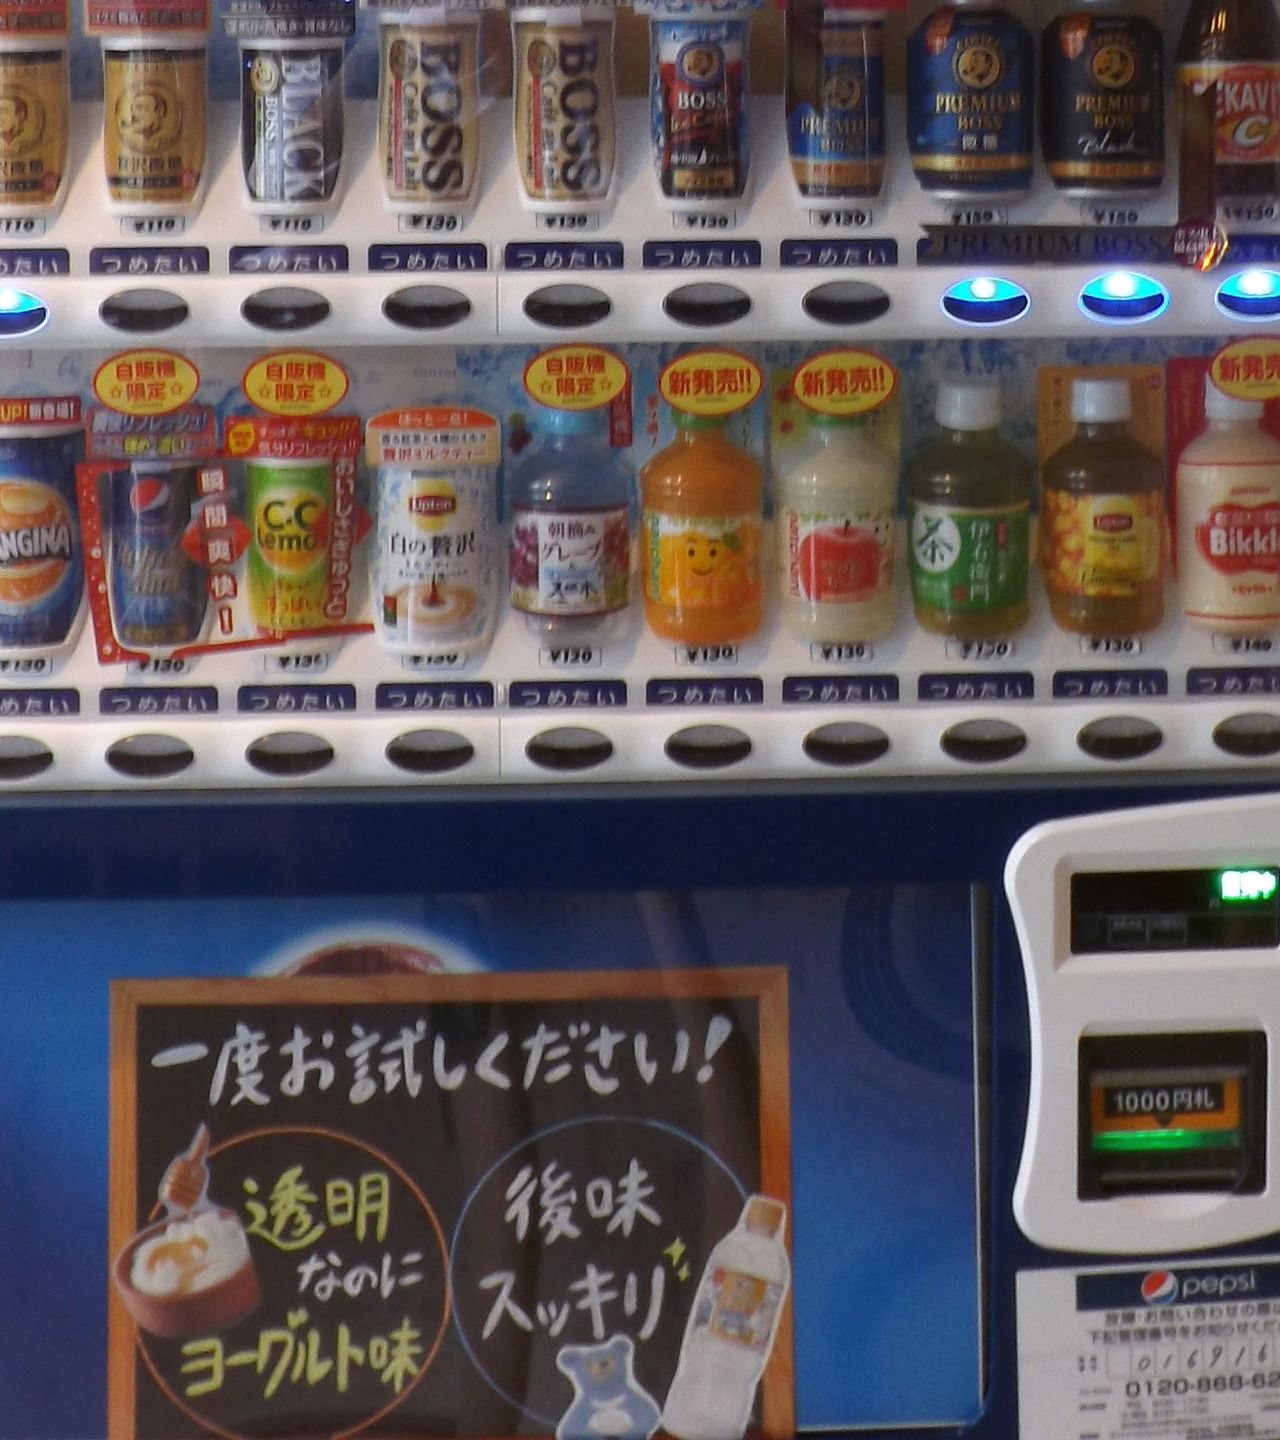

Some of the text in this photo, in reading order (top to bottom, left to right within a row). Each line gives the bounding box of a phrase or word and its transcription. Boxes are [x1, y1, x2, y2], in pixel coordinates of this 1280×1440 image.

[677, 91, 728, 111] BOSS
[935, 92, 1022, 113] PREMIUM
[1075, 94, 1150, 113] PREMIUM
[264, 96, 279, 142] BOSS
[421, 43, 464, 192] BOSS
[559, 39, 601, 192] BOSS
[958, 114, 1003, 130] BOSS
[1094, 113, 1135, 130] BOSS
[280, 55, 325, 200] BLACK
[100, 255, 198, 274] つめたい
[240, 253, 338, 273] つめたい
[378, 251, 477, 271] つめたい
[516, 250, 614, 269] つめたい
[654, 249, 751, 268] つめたい
[790, 247, 888, 266] つめたい
[115, 359, 176, 381] 自販機
[264, 361, 326, 382] 自販機
[545, 357, 606, 376] 自販機
[126, 382, 166, 401] 限定
[275, 382, 314, 402] 限定
[556, 377, 595, 398] 限定
[668, 369, 753, 396] 新発売!!
[801, 367, 887, 397] 新発売!!
[383, 446, 487, 464] 贅沢ミルクティー
[915, 516, 955, 566] 茶
[520, 688, 617, 706] つめたい
[657, 686, 754, 704] つめたい
[794, 685, 888, 703] つめたい
[929, 680, 1025, 698] つめたい
[1063, 678, 1158, 697] つめたい
[111, 694, 208, 711] つめたい
[249, 693, 345, 710] つめたい
[387, 691, 483, 709] つめたい
[151, 1013, 734, 1108] 一度お試しください!
[1114, 1087, 1215, 1113] 1000円札
[242, 1164, 391, 1252] 透明
[505, 1157, 665, 1246] 後味
[296, 1251, 425, 1302] なのに
[1181, 1269, 1258, 1300] pepsi
[479, 1265, 666, 1341] スッキリ
[180, 1309, 424, 1400] ヨーグルト味
